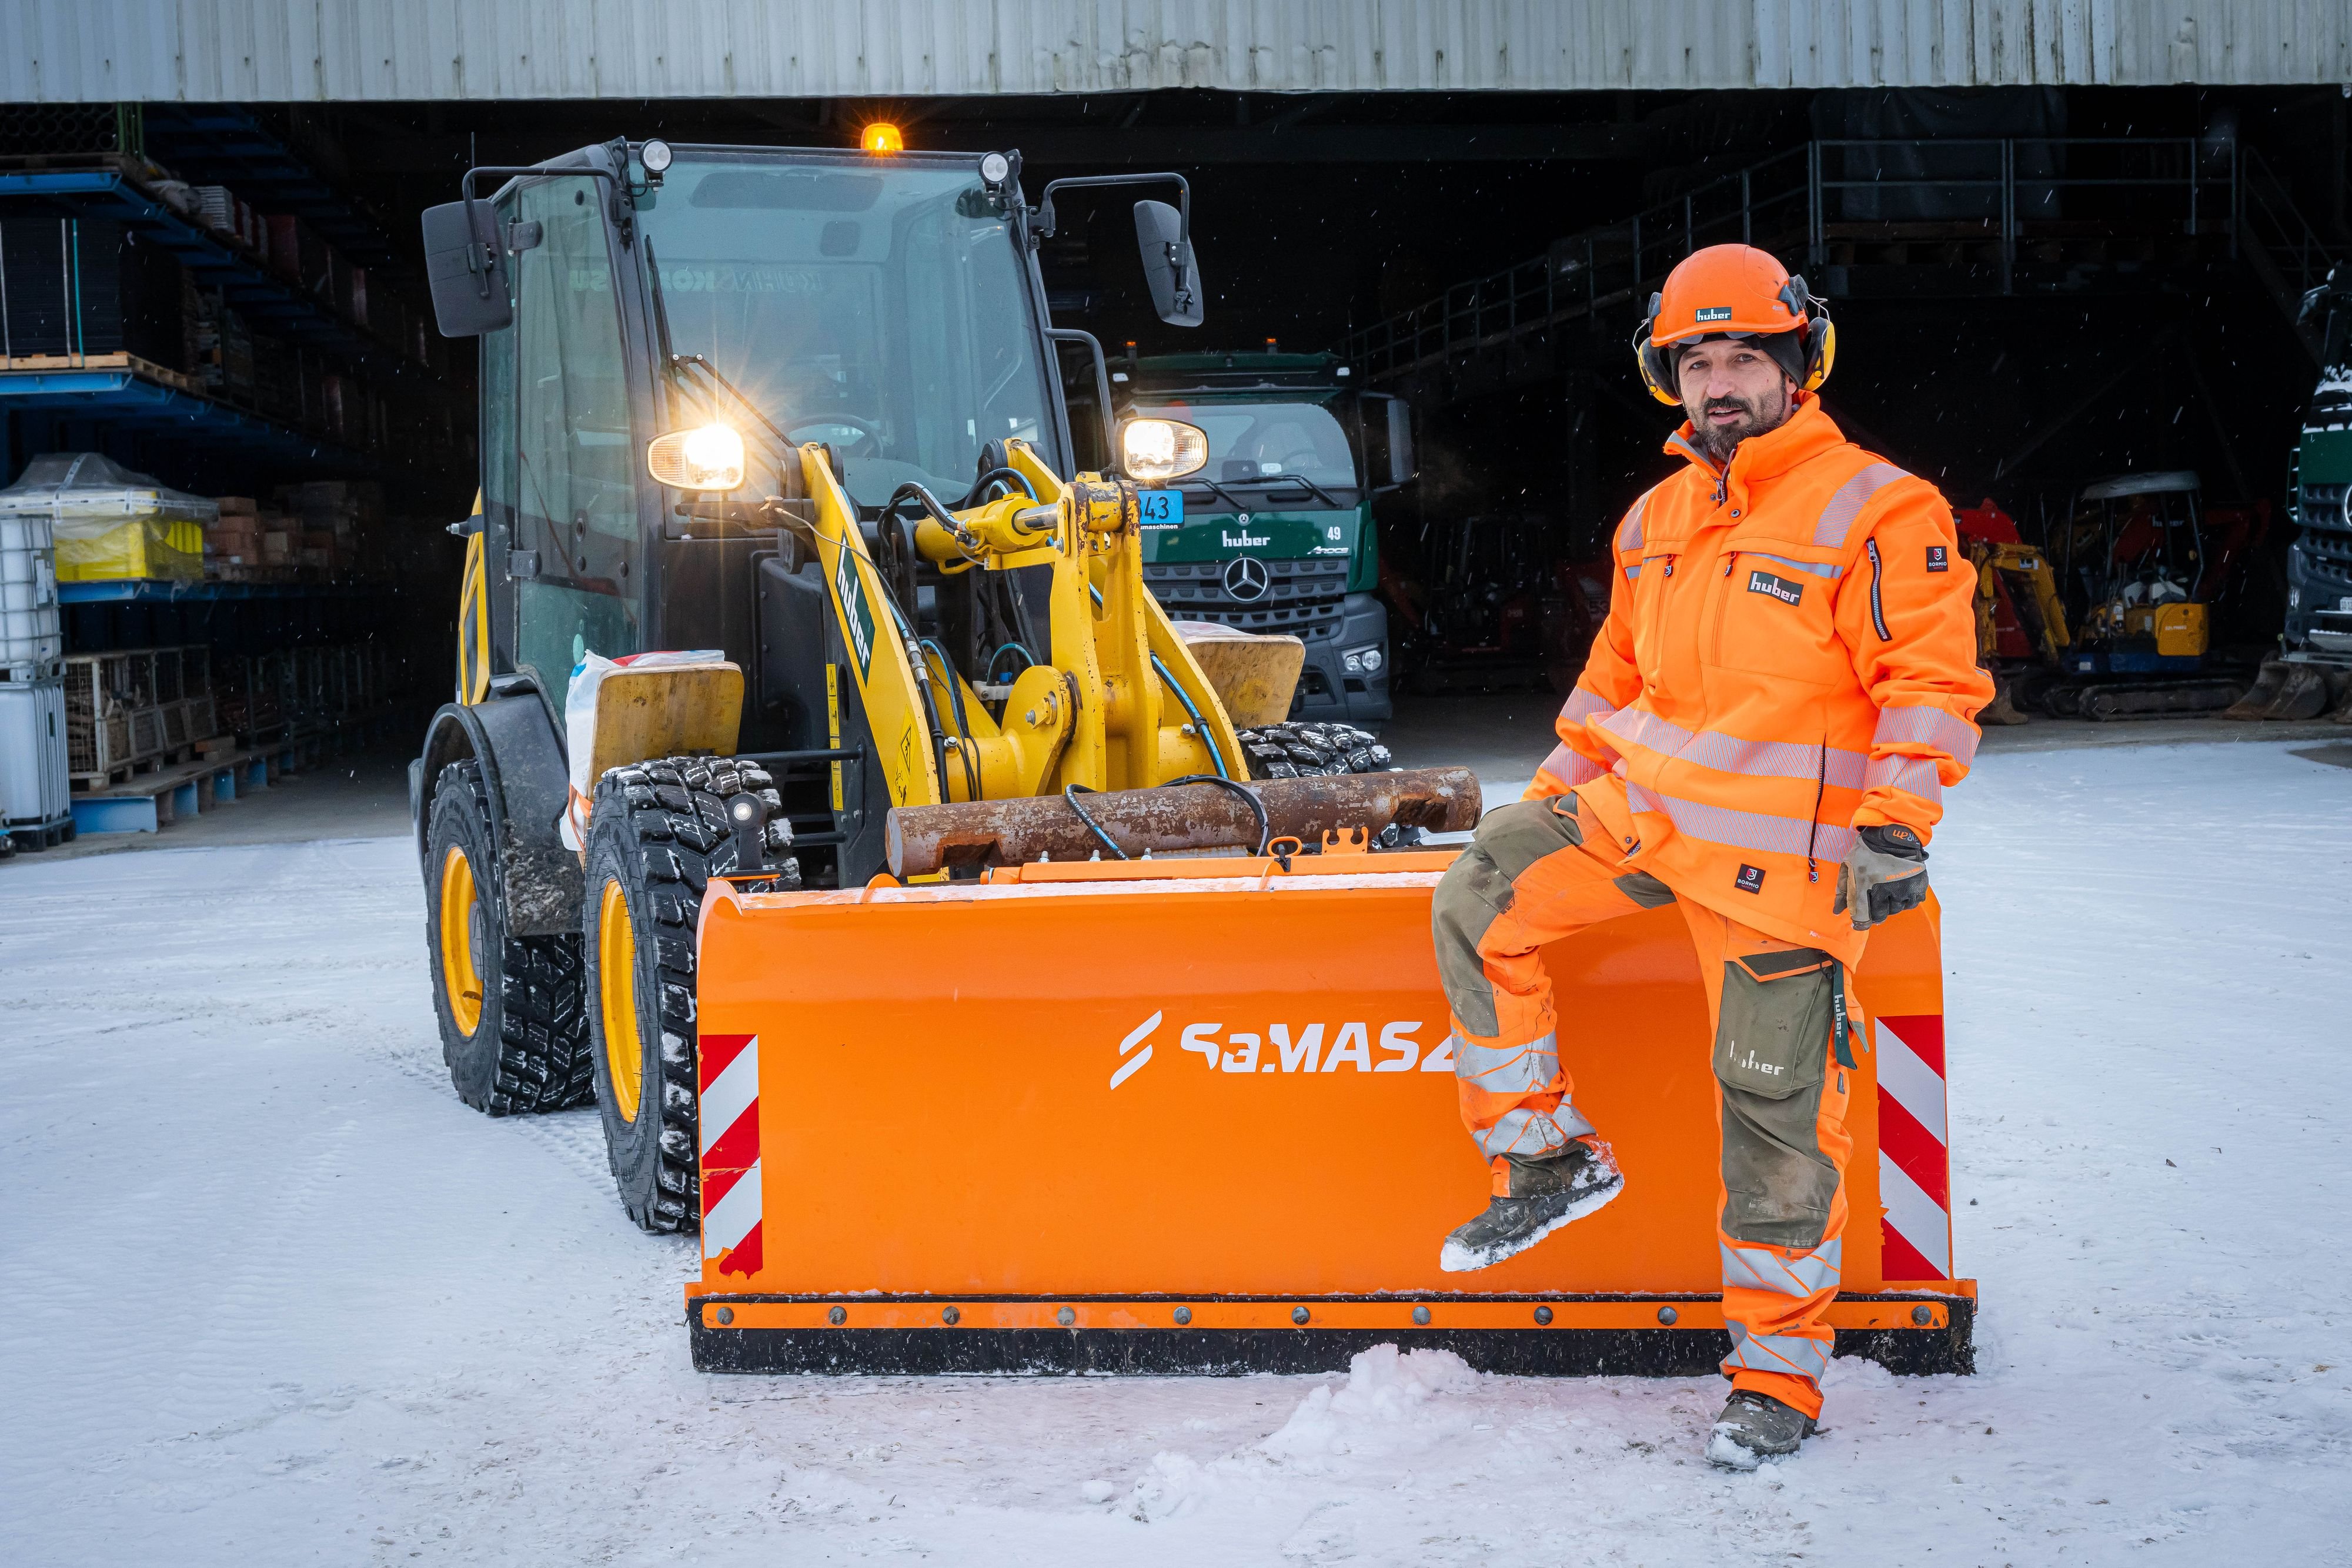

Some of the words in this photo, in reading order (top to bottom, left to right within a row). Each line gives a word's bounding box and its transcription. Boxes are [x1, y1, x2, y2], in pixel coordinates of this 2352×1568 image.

[1697, 309, 1730, 321] huber
[1138, 496, 1169, 520] 43
[1222, 530, 1270, 547] huber
[1328, 527, 1341, 540] 49
[1750, 573, 1799, 603] huber
[837, 536, 870, 668] huber
[1738, 879, 1759, 889] BORMIO
[1835, 994, 1846, 1038] huber
